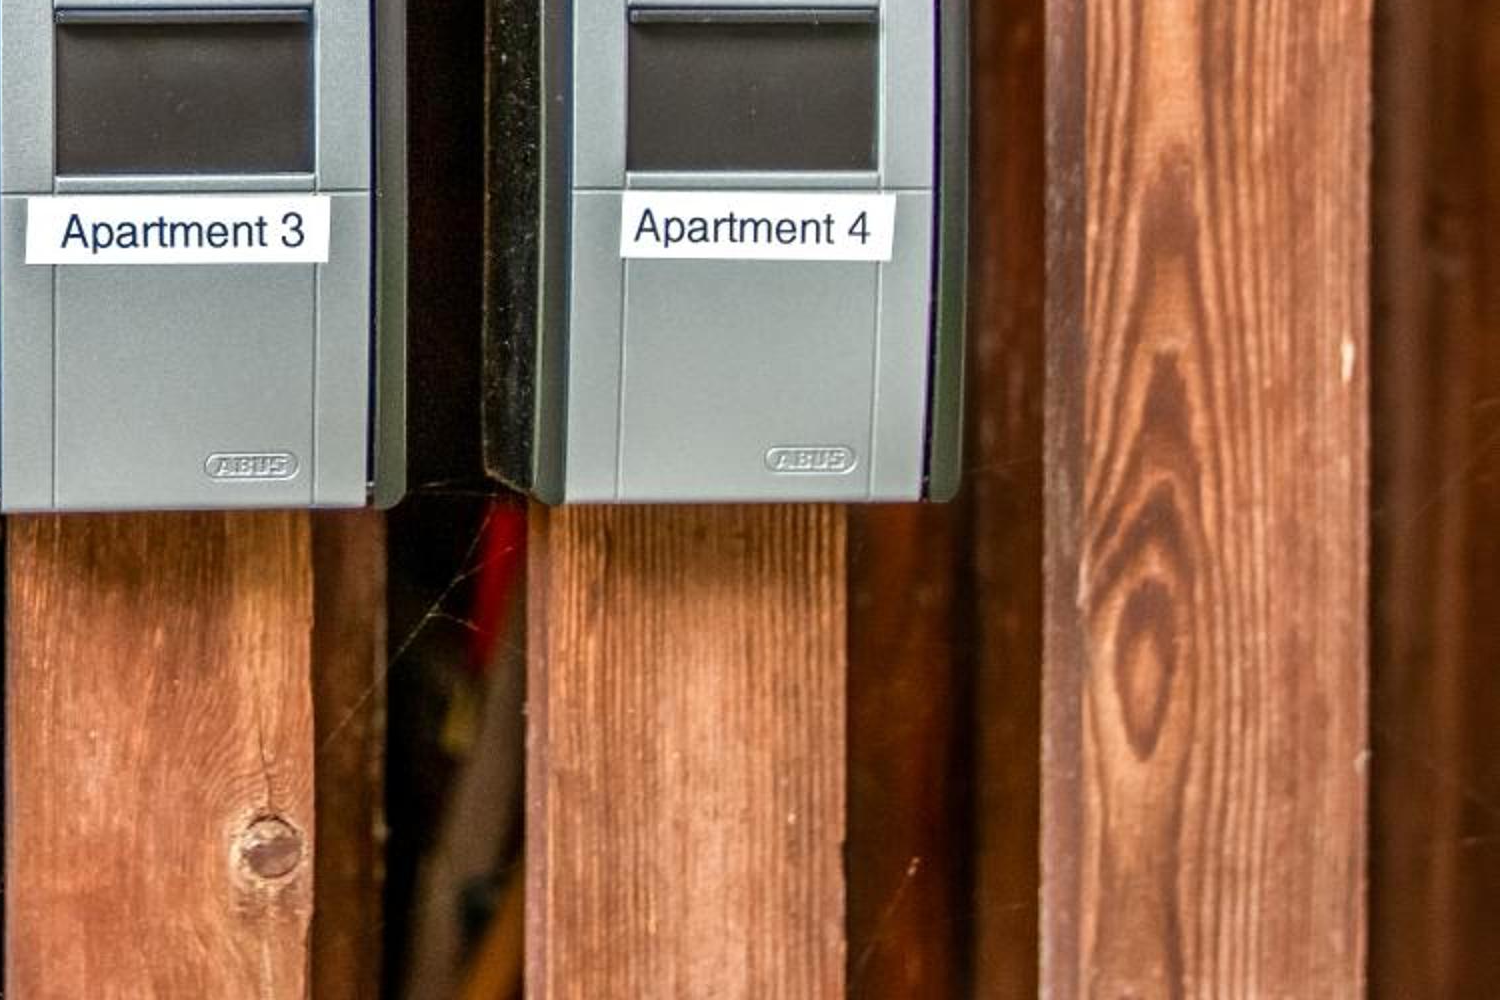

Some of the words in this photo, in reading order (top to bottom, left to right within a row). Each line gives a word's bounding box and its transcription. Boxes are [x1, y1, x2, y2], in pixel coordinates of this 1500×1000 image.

[61, 213, 268, 255] Apartment
[281, 211, 305, 248] 3
[634, 208, 835, 249] Apartment
[847, 211, 871, 245] 4
[216, 456, 288, 477] ABUS
[776, 450, 847, 471] ABUS
